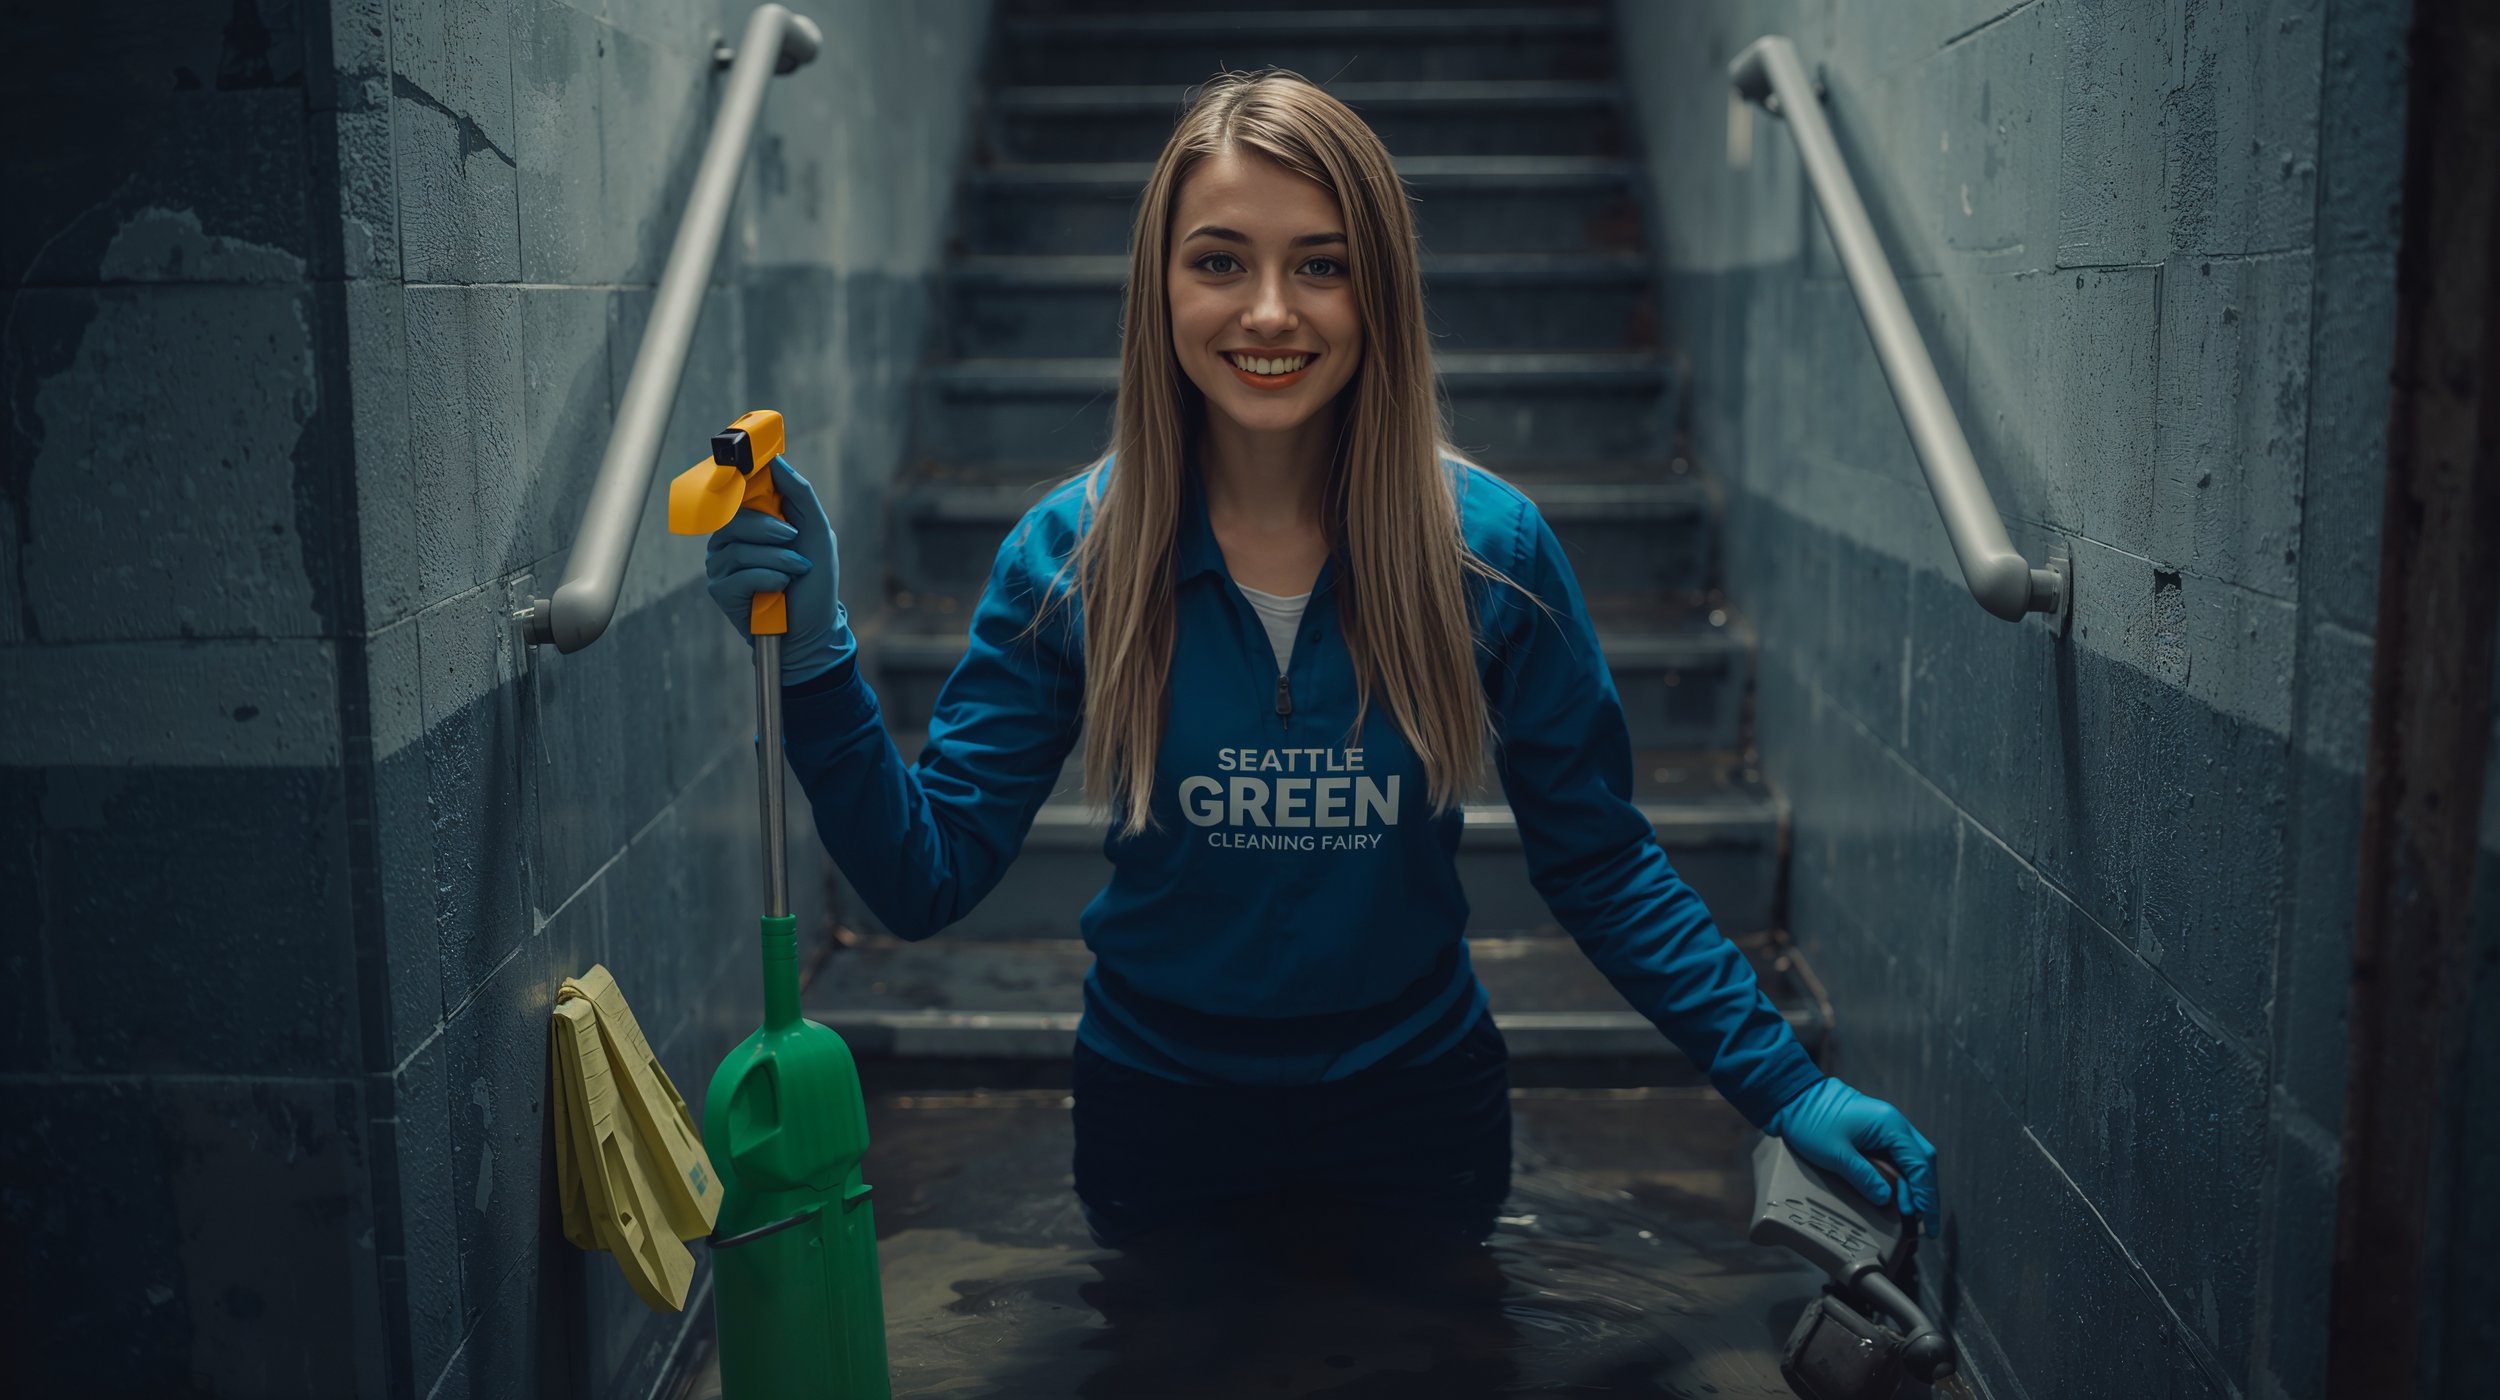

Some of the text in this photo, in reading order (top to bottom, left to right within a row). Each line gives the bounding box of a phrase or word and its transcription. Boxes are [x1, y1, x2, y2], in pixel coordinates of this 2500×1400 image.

[1218, 747, 1364, 772] SEATTLE
[1179, 775, 1400, 827] GREEN
[1208, 832, 1382, 851] CLEANING FAIRY
